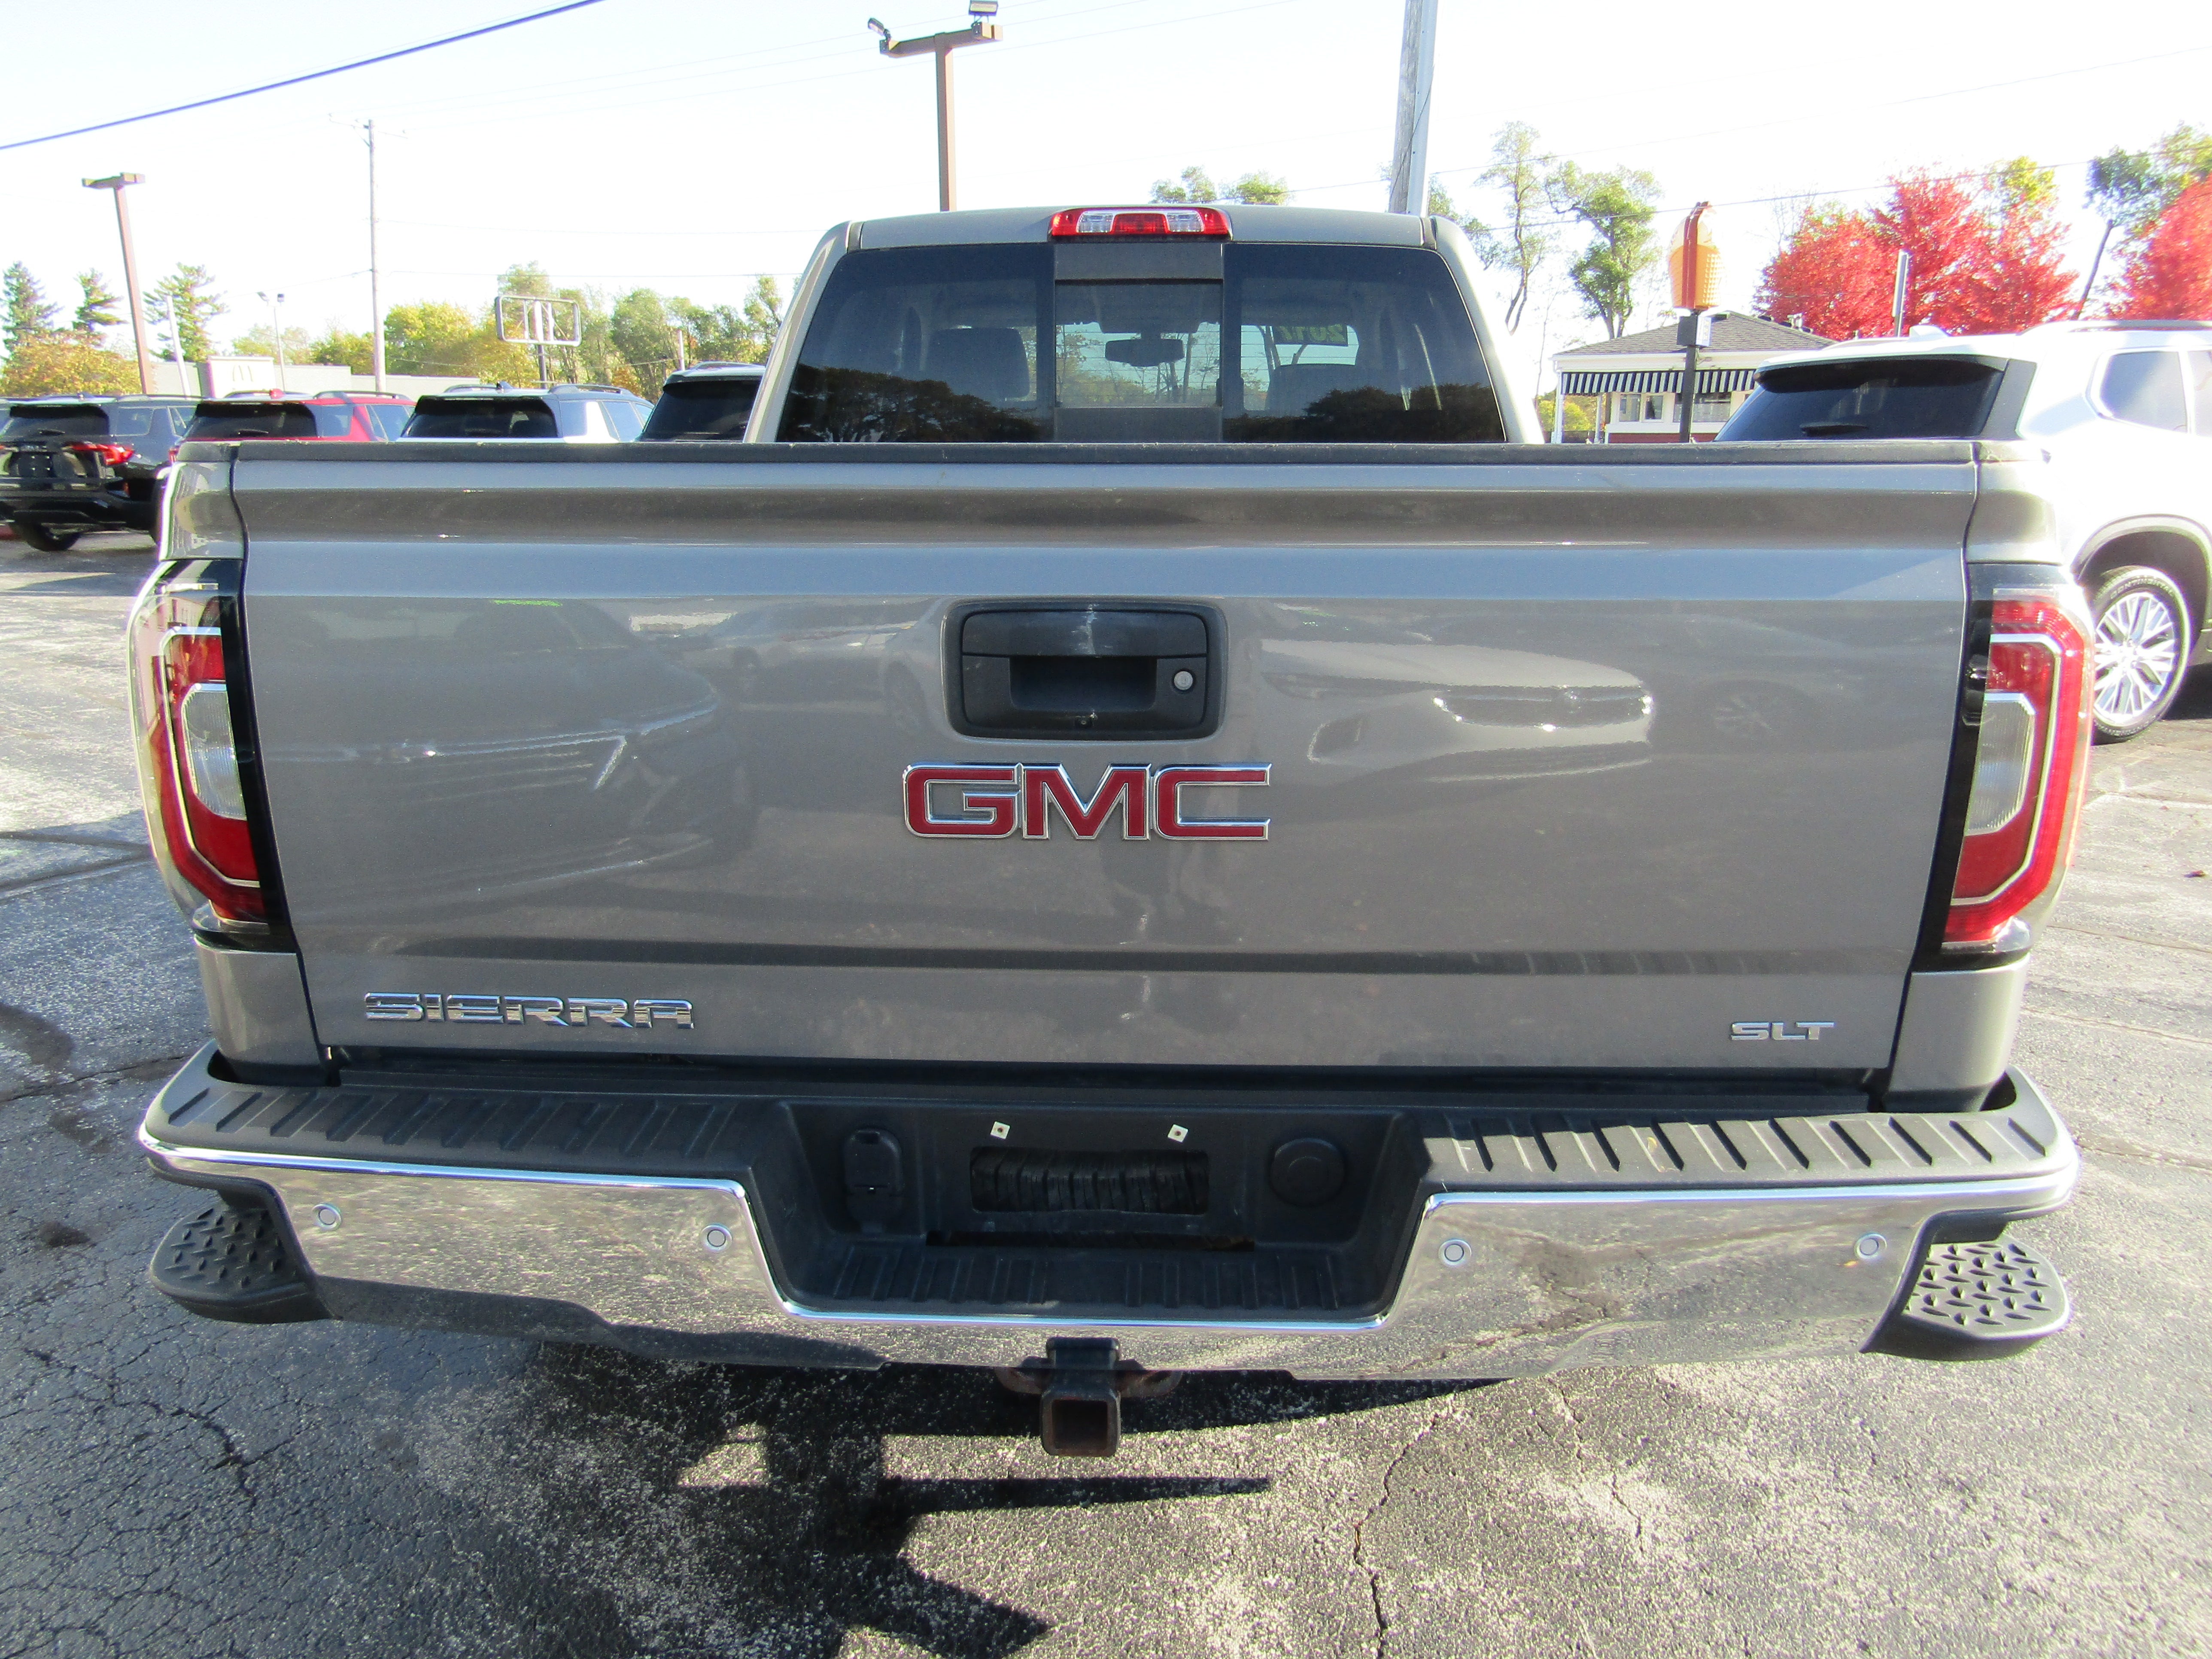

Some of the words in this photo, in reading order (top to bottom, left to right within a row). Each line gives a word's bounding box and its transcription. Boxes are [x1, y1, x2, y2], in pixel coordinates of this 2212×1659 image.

[903, 762, 1272, 841] GMC
[364, 992, 694, 1029] SIERRA
[1730, 1021, 1835, 1040] SLT
